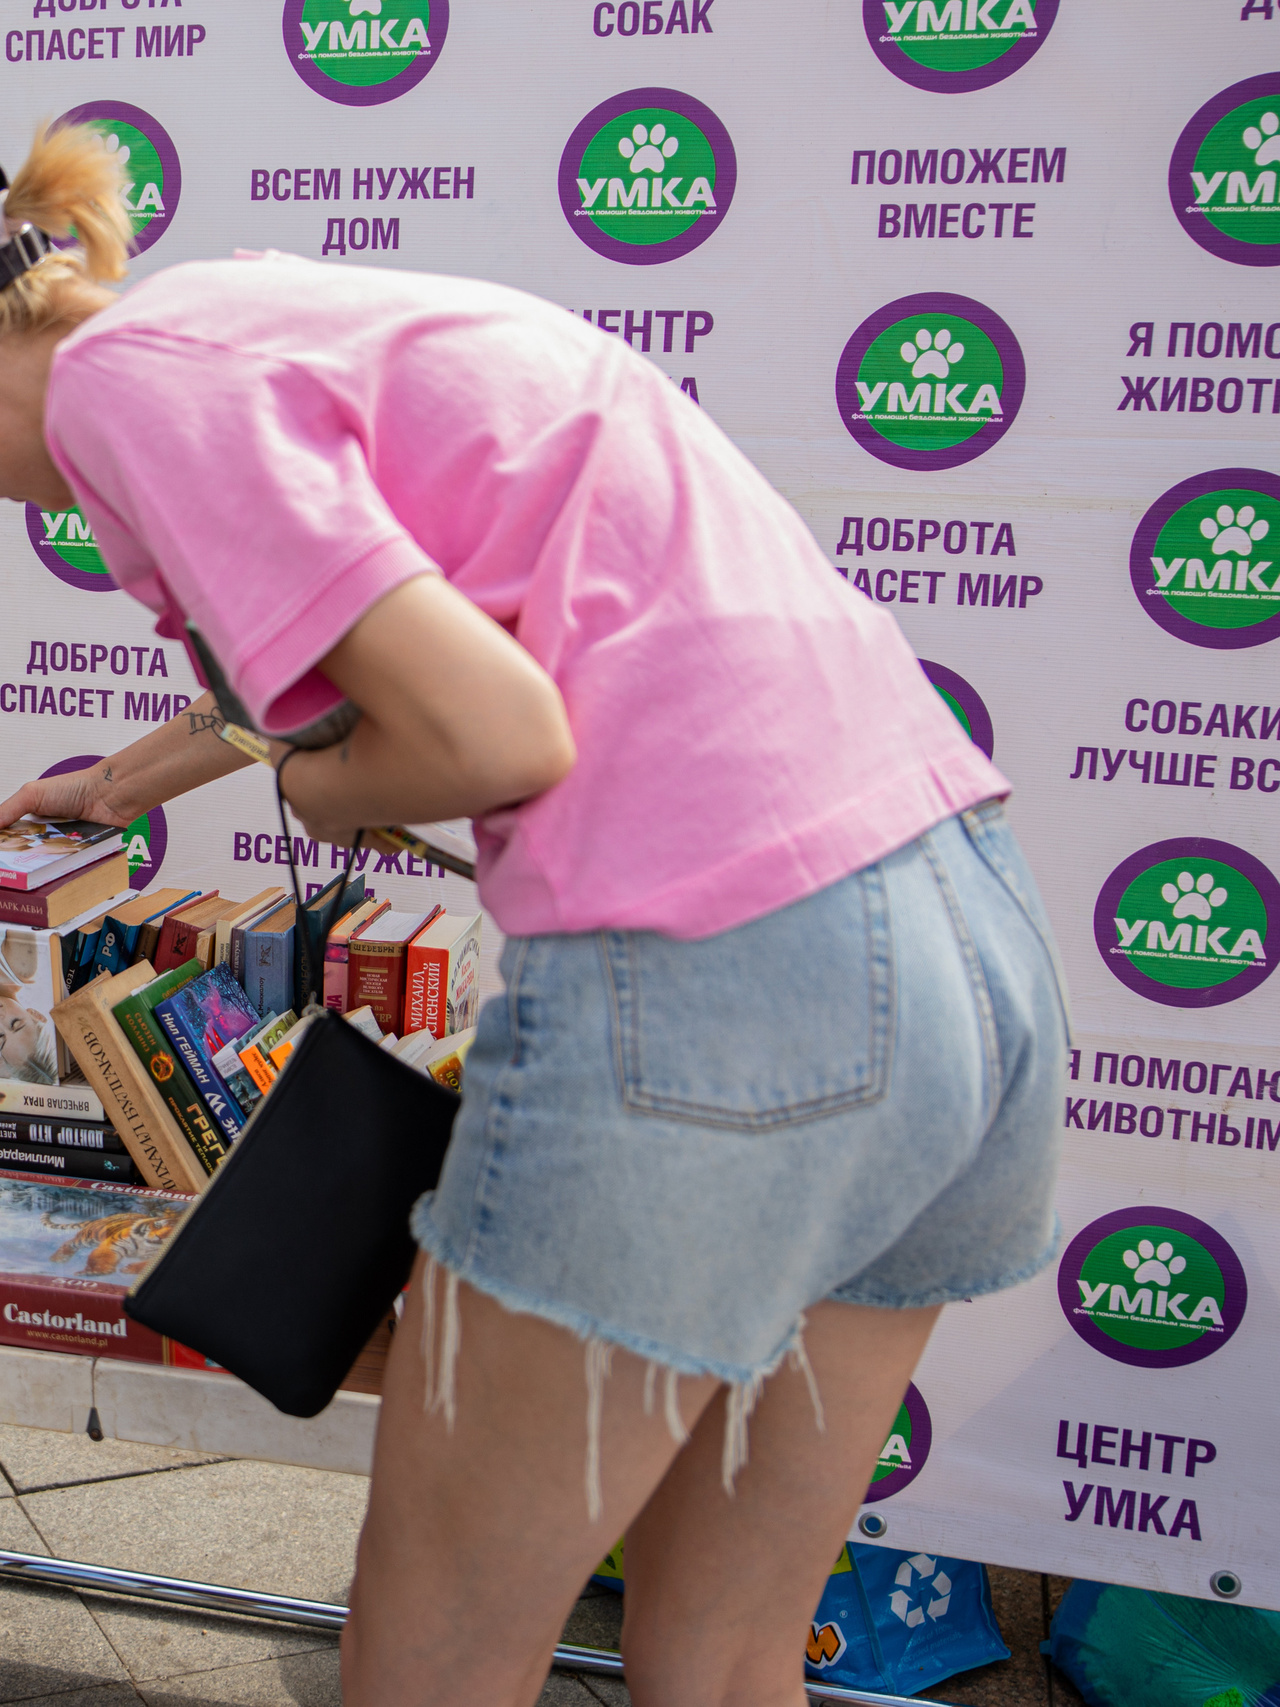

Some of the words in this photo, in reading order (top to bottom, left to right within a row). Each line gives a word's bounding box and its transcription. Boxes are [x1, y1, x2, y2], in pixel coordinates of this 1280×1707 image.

[299, 18, 431, 51] УМКА
[593, 0, 714, 37] СОБАК
[883, 0, 1038, 34] УМКА
[6, 27, 125, 62] СПАСЕТ
[136, 24, 206, 58] МИР
[251, 168, 341, 201] ВСЕМ
[353, 167, 474, 200] НУЖЕН
[851, 147, 1067, 185] ПОМОЖЕМ
[576, 177, 717, 208] УМКА
[1189, 171, 1280, 204] УМ
[322, 217, 400, 256] ДОМ
[878, 203, 1036, 239] ВМЕСТЕ
[570, 309, 715, 354] ЕНТР
[1126, 322, 1154, 357] Я
[1167, 322, 1280, 359] ПОМО
[854, 382, 1004, 414] УМКА
[1117, 375, 1280, 415] ЖИВОТ
[39, 512, 97, 541] УМ
[836, 517, 1016, 556] ДОБРОТА
[838, 567, 946, 605] АСЕТ
[957, 573, 1043, 608] МИР
[26, 641, 168, 677] ДОБРОТА
[0, 683, 114, 718] СПАСЕТ
[124, 691, 192, 724] МИР
[1124, 698, 1280, 742] СОБАКИ
[1070, 746, 1217, 788] ЛУЧШЕ
[1229, 756, 1280, 793] ВС
[233, 831, 320, 868] ВСЕМ
[18, 903, 44, 915] ЛЕВИ
[1113, 917, 1267, 959] УМКА
[411, 970, 425, 1029] МИХАИЛ
[161, 1012, 179, 1037] Нил
[176, 1036, 210, 1084] ГЕЙМАН
[83, 1031, 141, 1121] БУЛГАКОВ
[23, 1095, 46, 1107] ПРАХ
[47, 1099, 90, 1113] ВЯЧЕСЛАВ
[29, 1123, 53, 1143] КТО
[57, 1125, 104, 1149] ДОКТОР
[90, 1181, 200, 1202] Castorland
[3, 1302, 128, 1338] Castorland
[1076, 1279, 1224, 1325] УМКА
[26, 1329, 109, 1348] www.castorland.pl
[1056, 1420, 1216, 1477] ЦЕНТР
[1063, 1480, 1202, 1541] УМКА
